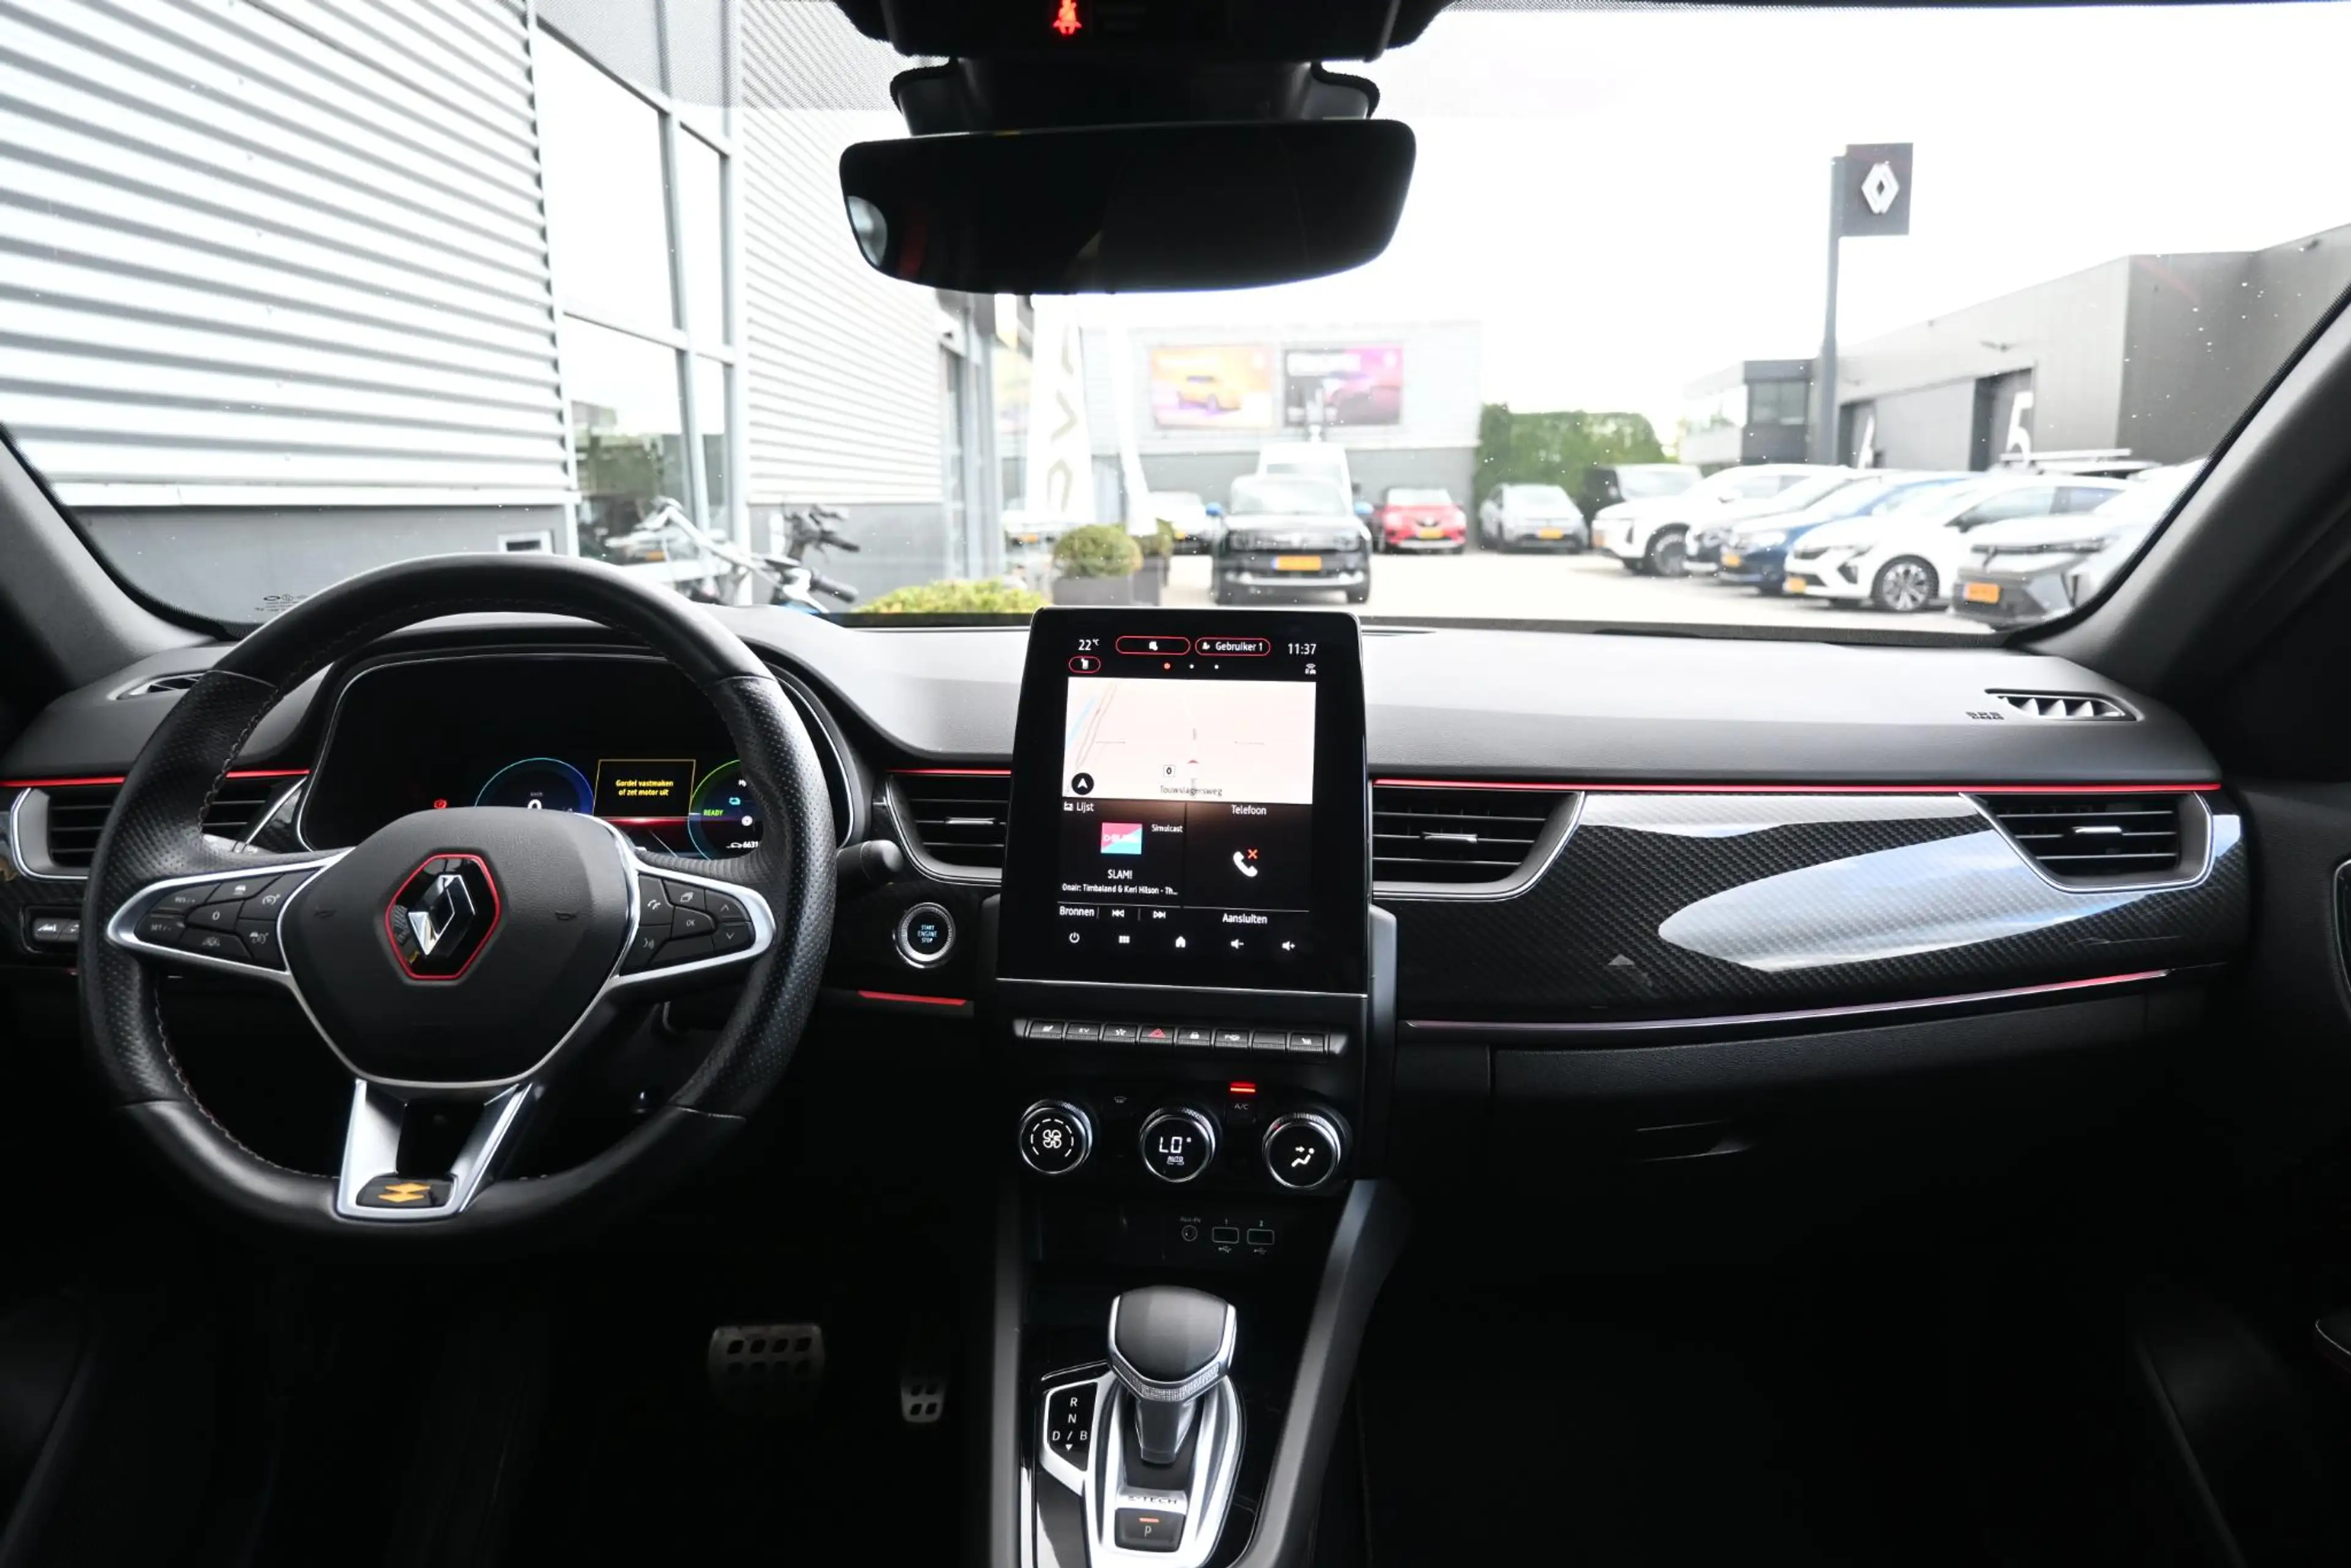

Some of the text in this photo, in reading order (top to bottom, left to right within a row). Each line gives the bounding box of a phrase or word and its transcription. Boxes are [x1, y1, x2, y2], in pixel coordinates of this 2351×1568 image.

[1215, 641, 1263, 651] Gebruiker 1
[1288, 643, 1316, 655] 11:37
[615, 779, 674, 787] Gordel vastmaken
[1076, 802, 1094, 813] Lijst
[1231, 804, 1267, 816] Telefoon
[1151, 823, 1183, 833] Simulcast
[1108, 869, 1133, 879] SLAM!
[1124, 885, 1138, 894] Keri
[1139, 886, 1159, 895] Hilson
[1059, 906, 1095, 917] Bronnen
[1222, 912, 1267, 925] Aansluiten
[1070, 1397, 1078, 1407] R
[1068, 1413, 1077, 1424] N
[1052, 1430, 1060, 1441] D
[1080, 1430, 1088, 1441] B
[1144, 1525, 1152, 1538] P
